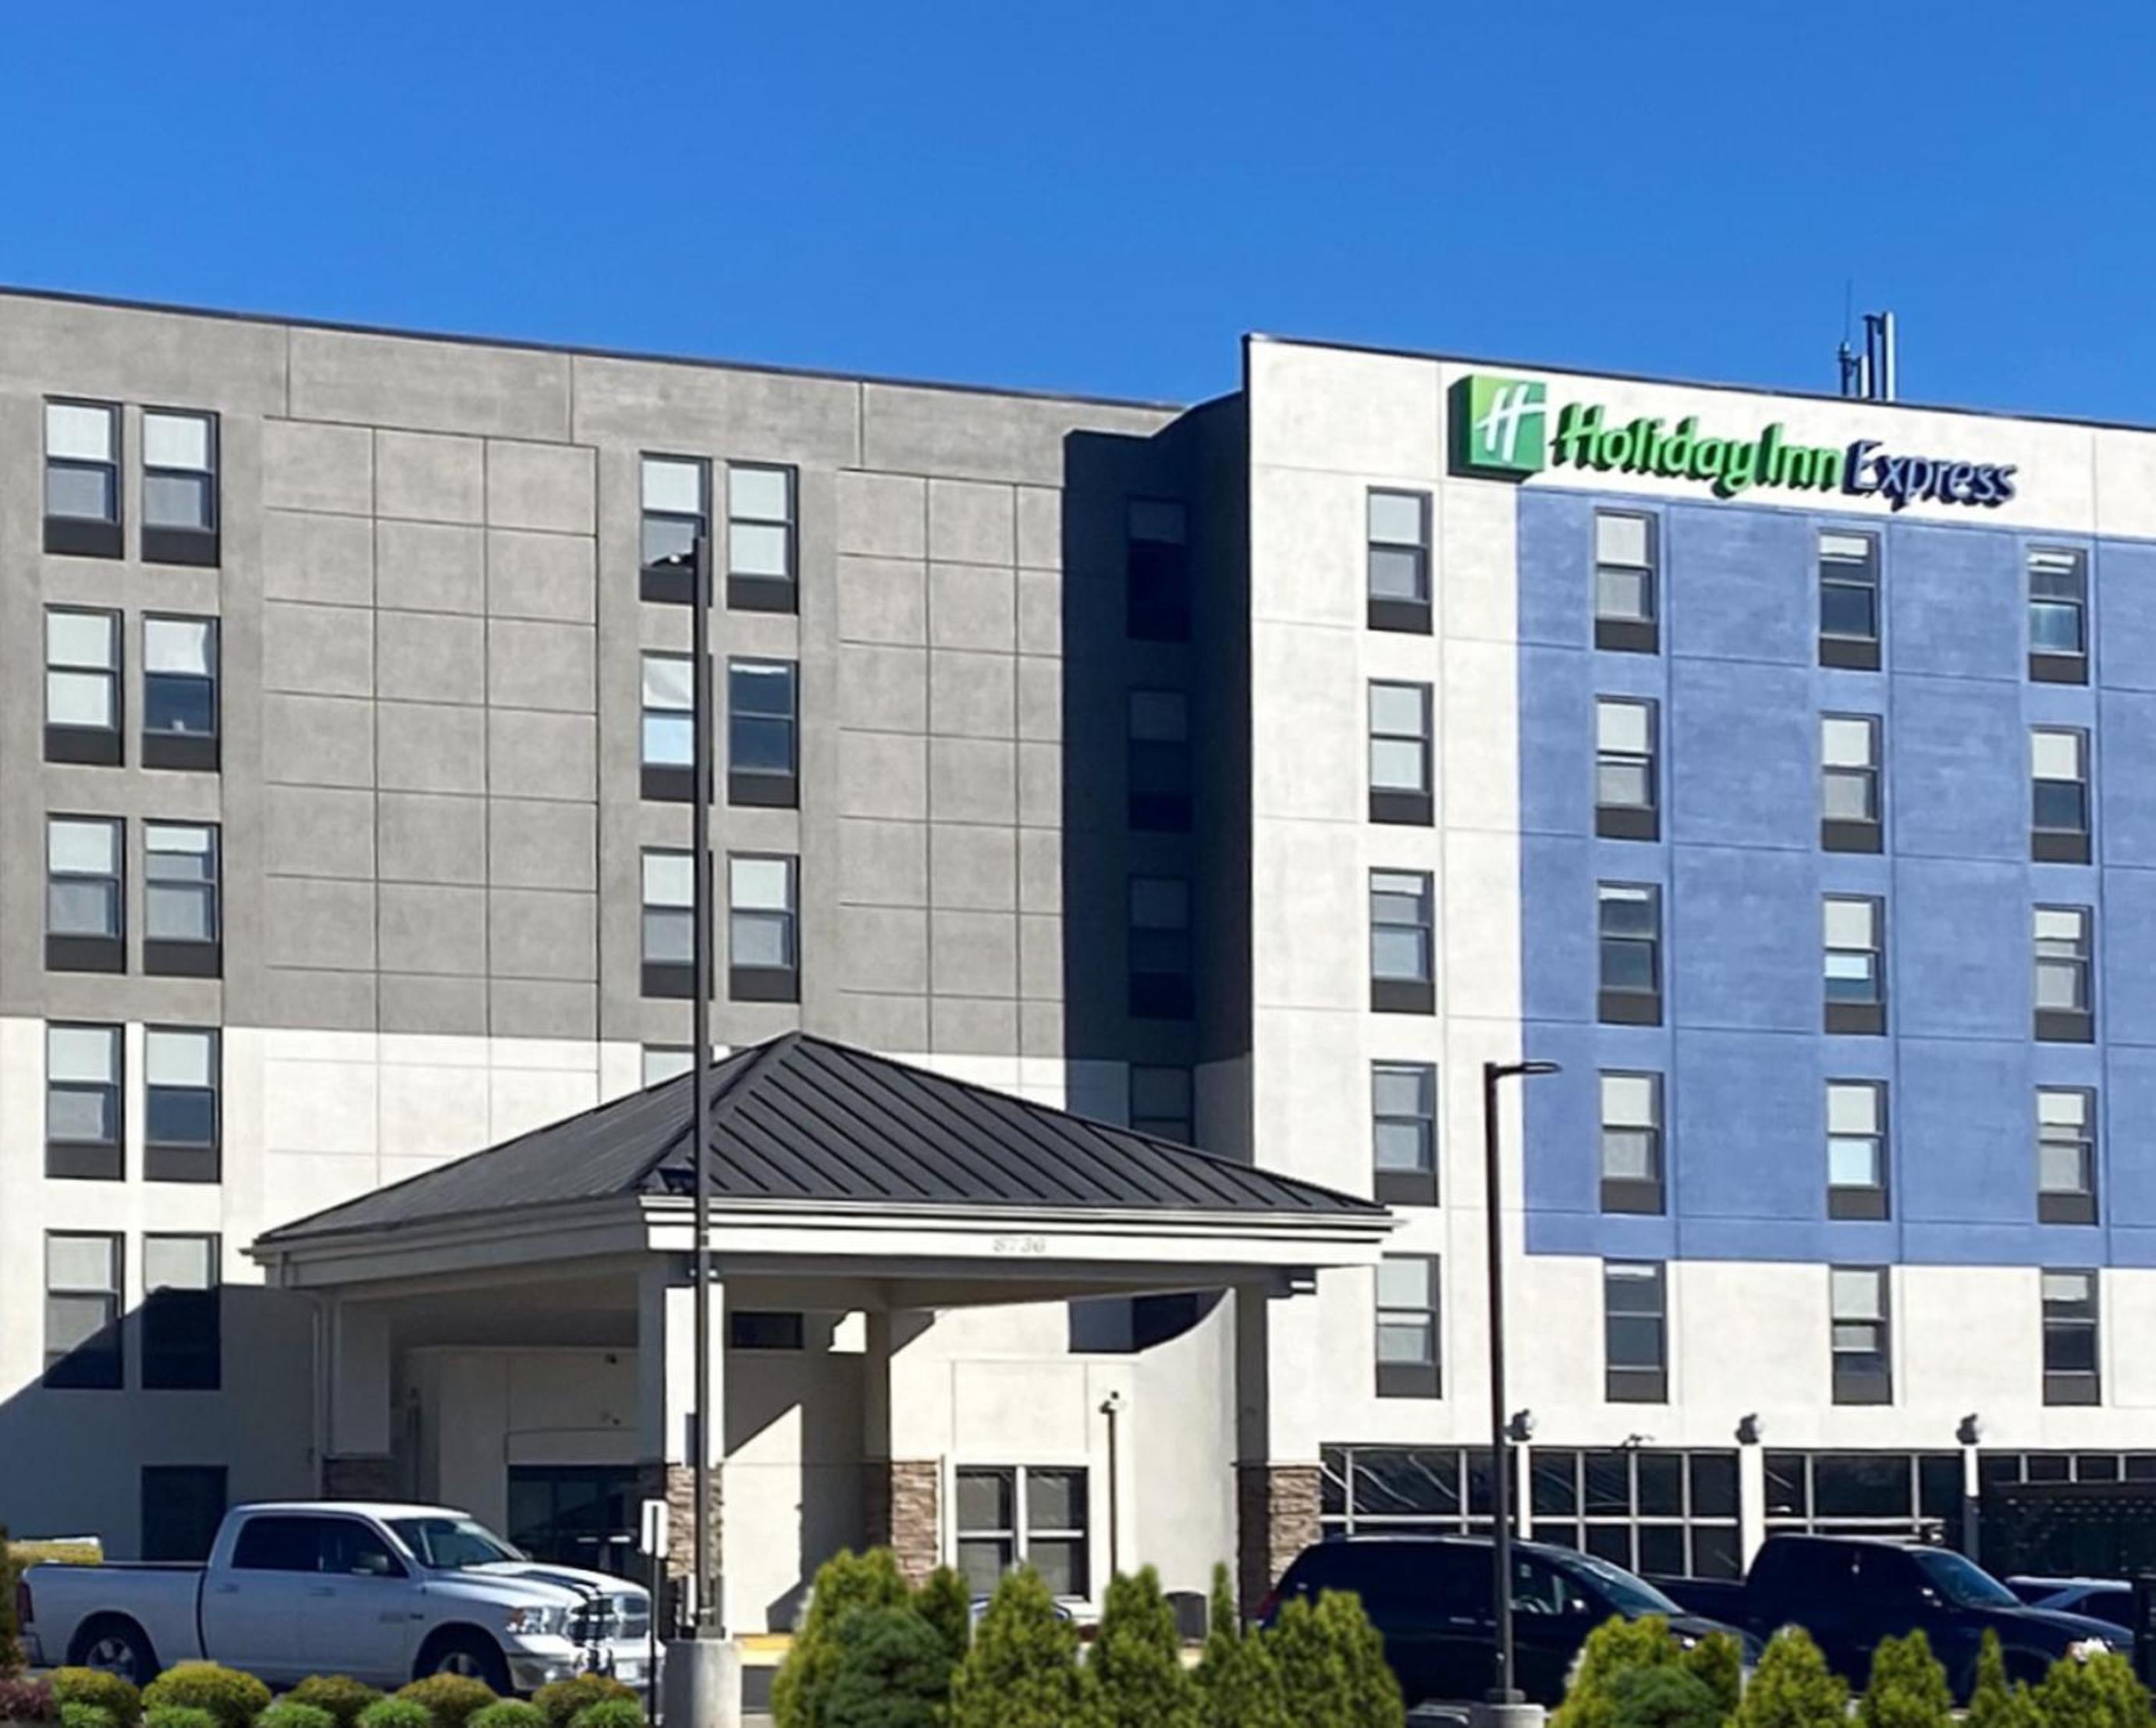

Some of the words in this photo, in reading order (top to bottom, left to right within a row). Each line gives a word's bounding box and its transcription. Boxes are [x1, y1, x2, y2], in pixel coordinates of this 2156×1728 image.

[1550, 402, 1759, 499] Holiday
[1757, 422, 1842, 492] Inn
[1841, 439, 2018, 512] Express
